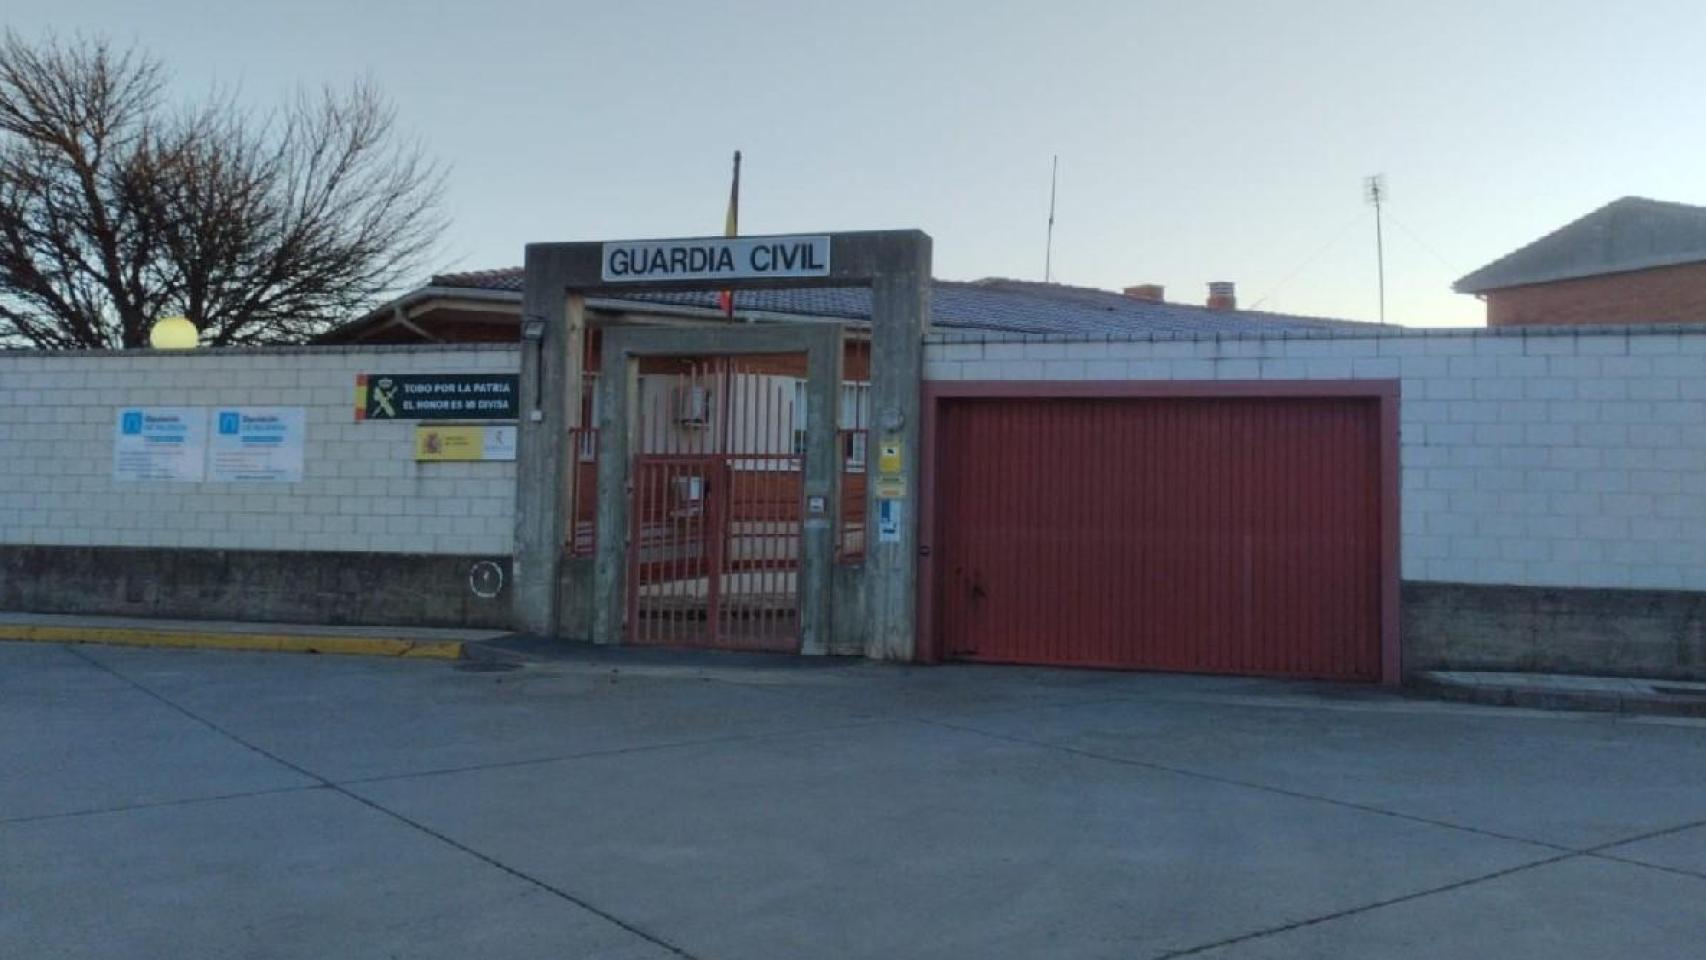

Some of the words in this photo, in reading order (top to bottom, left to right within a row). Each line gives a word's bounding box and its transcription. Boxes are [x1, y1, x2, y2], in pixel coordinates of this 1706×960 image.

[610, 245, 735, 275] GUARDIA
[750, 243, 824, 272] CIVIL
[404, 383, 432, 393] TODO
[434, 383, 455, 393] POR
[458, 383, 471, 393] LA
[474, 383, 510, 393] PATRIA
[403, 400, 415, 409] EL
[417, 400, 449, 410] HONOR
[451, 400, 463, 409] ES
